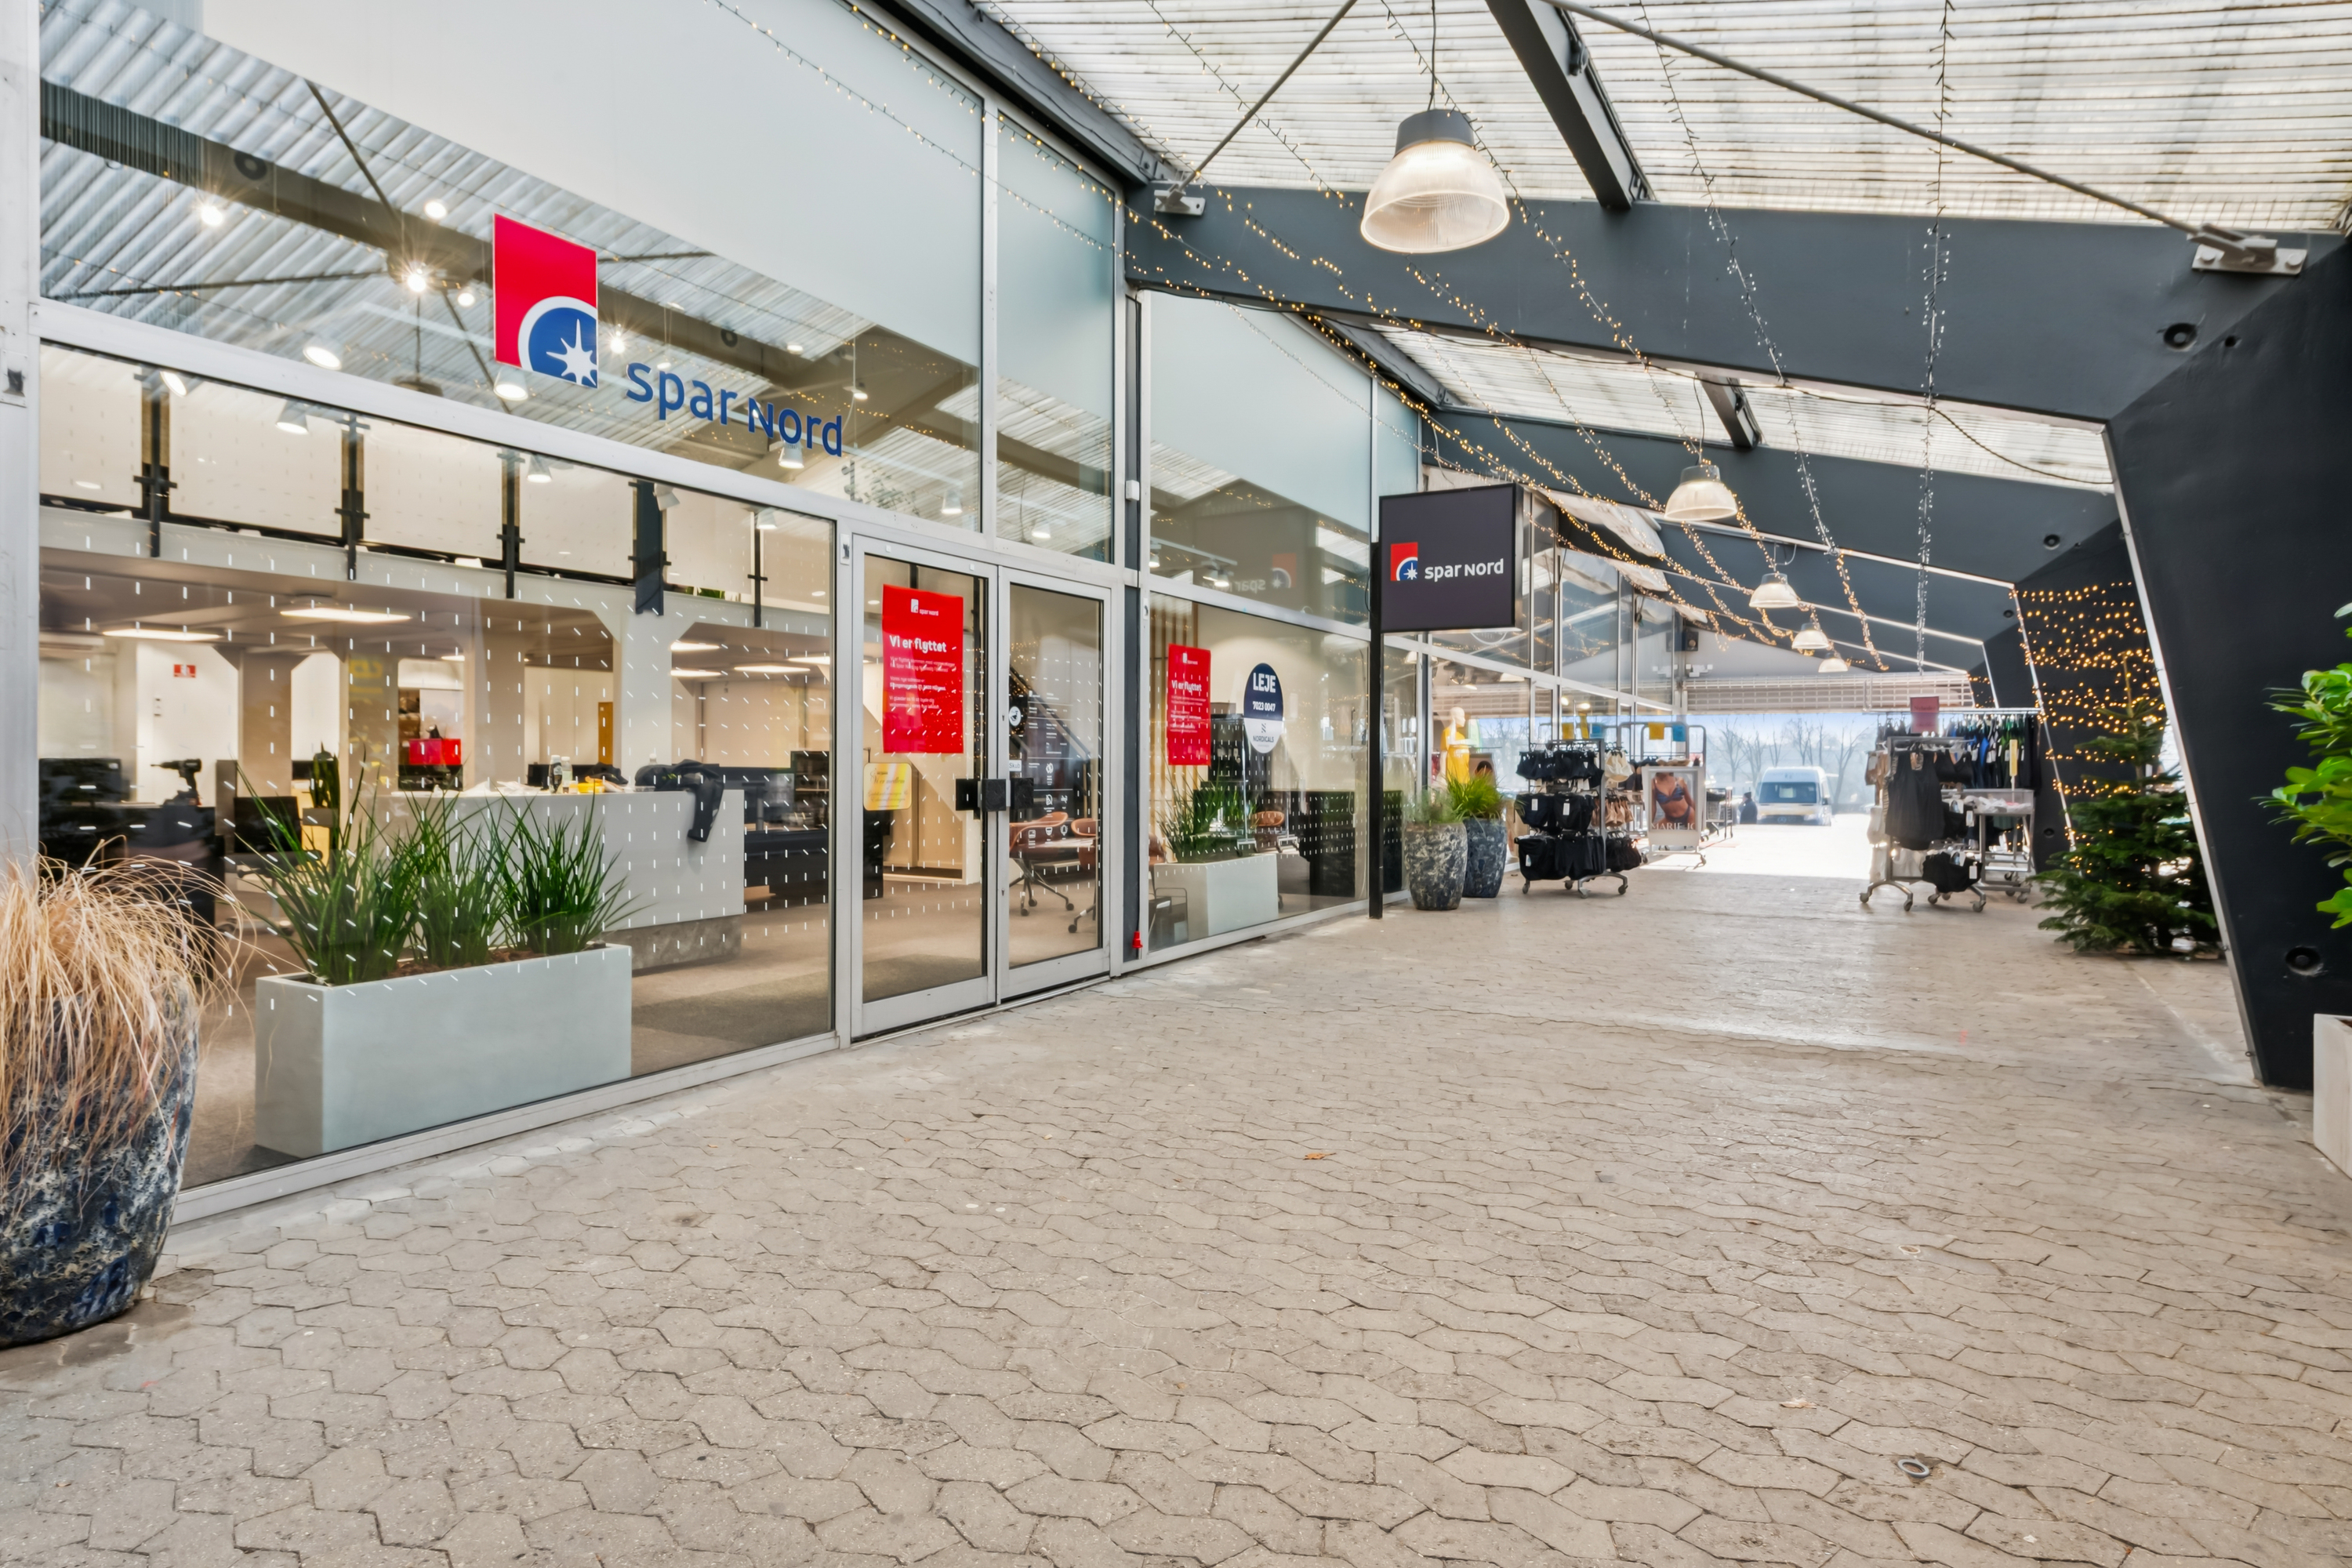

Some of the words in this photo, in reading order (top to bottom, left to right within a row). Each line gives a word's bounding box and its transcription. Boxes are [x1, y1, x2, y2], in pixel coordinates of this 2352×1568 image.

[889, 635, 901, 648] Vi
[902, 639, 913, 649] er
[914, 637, 947, 654] flyttet
[1171, 680, 1178, 689] Vi
[1184, 681, 1202, 693] flyttet
[1253, 672, 1276, 693] LEJE
[1252, 701, 1264, 711] 7023
[1650, 822, 1684, 830] MARIE
